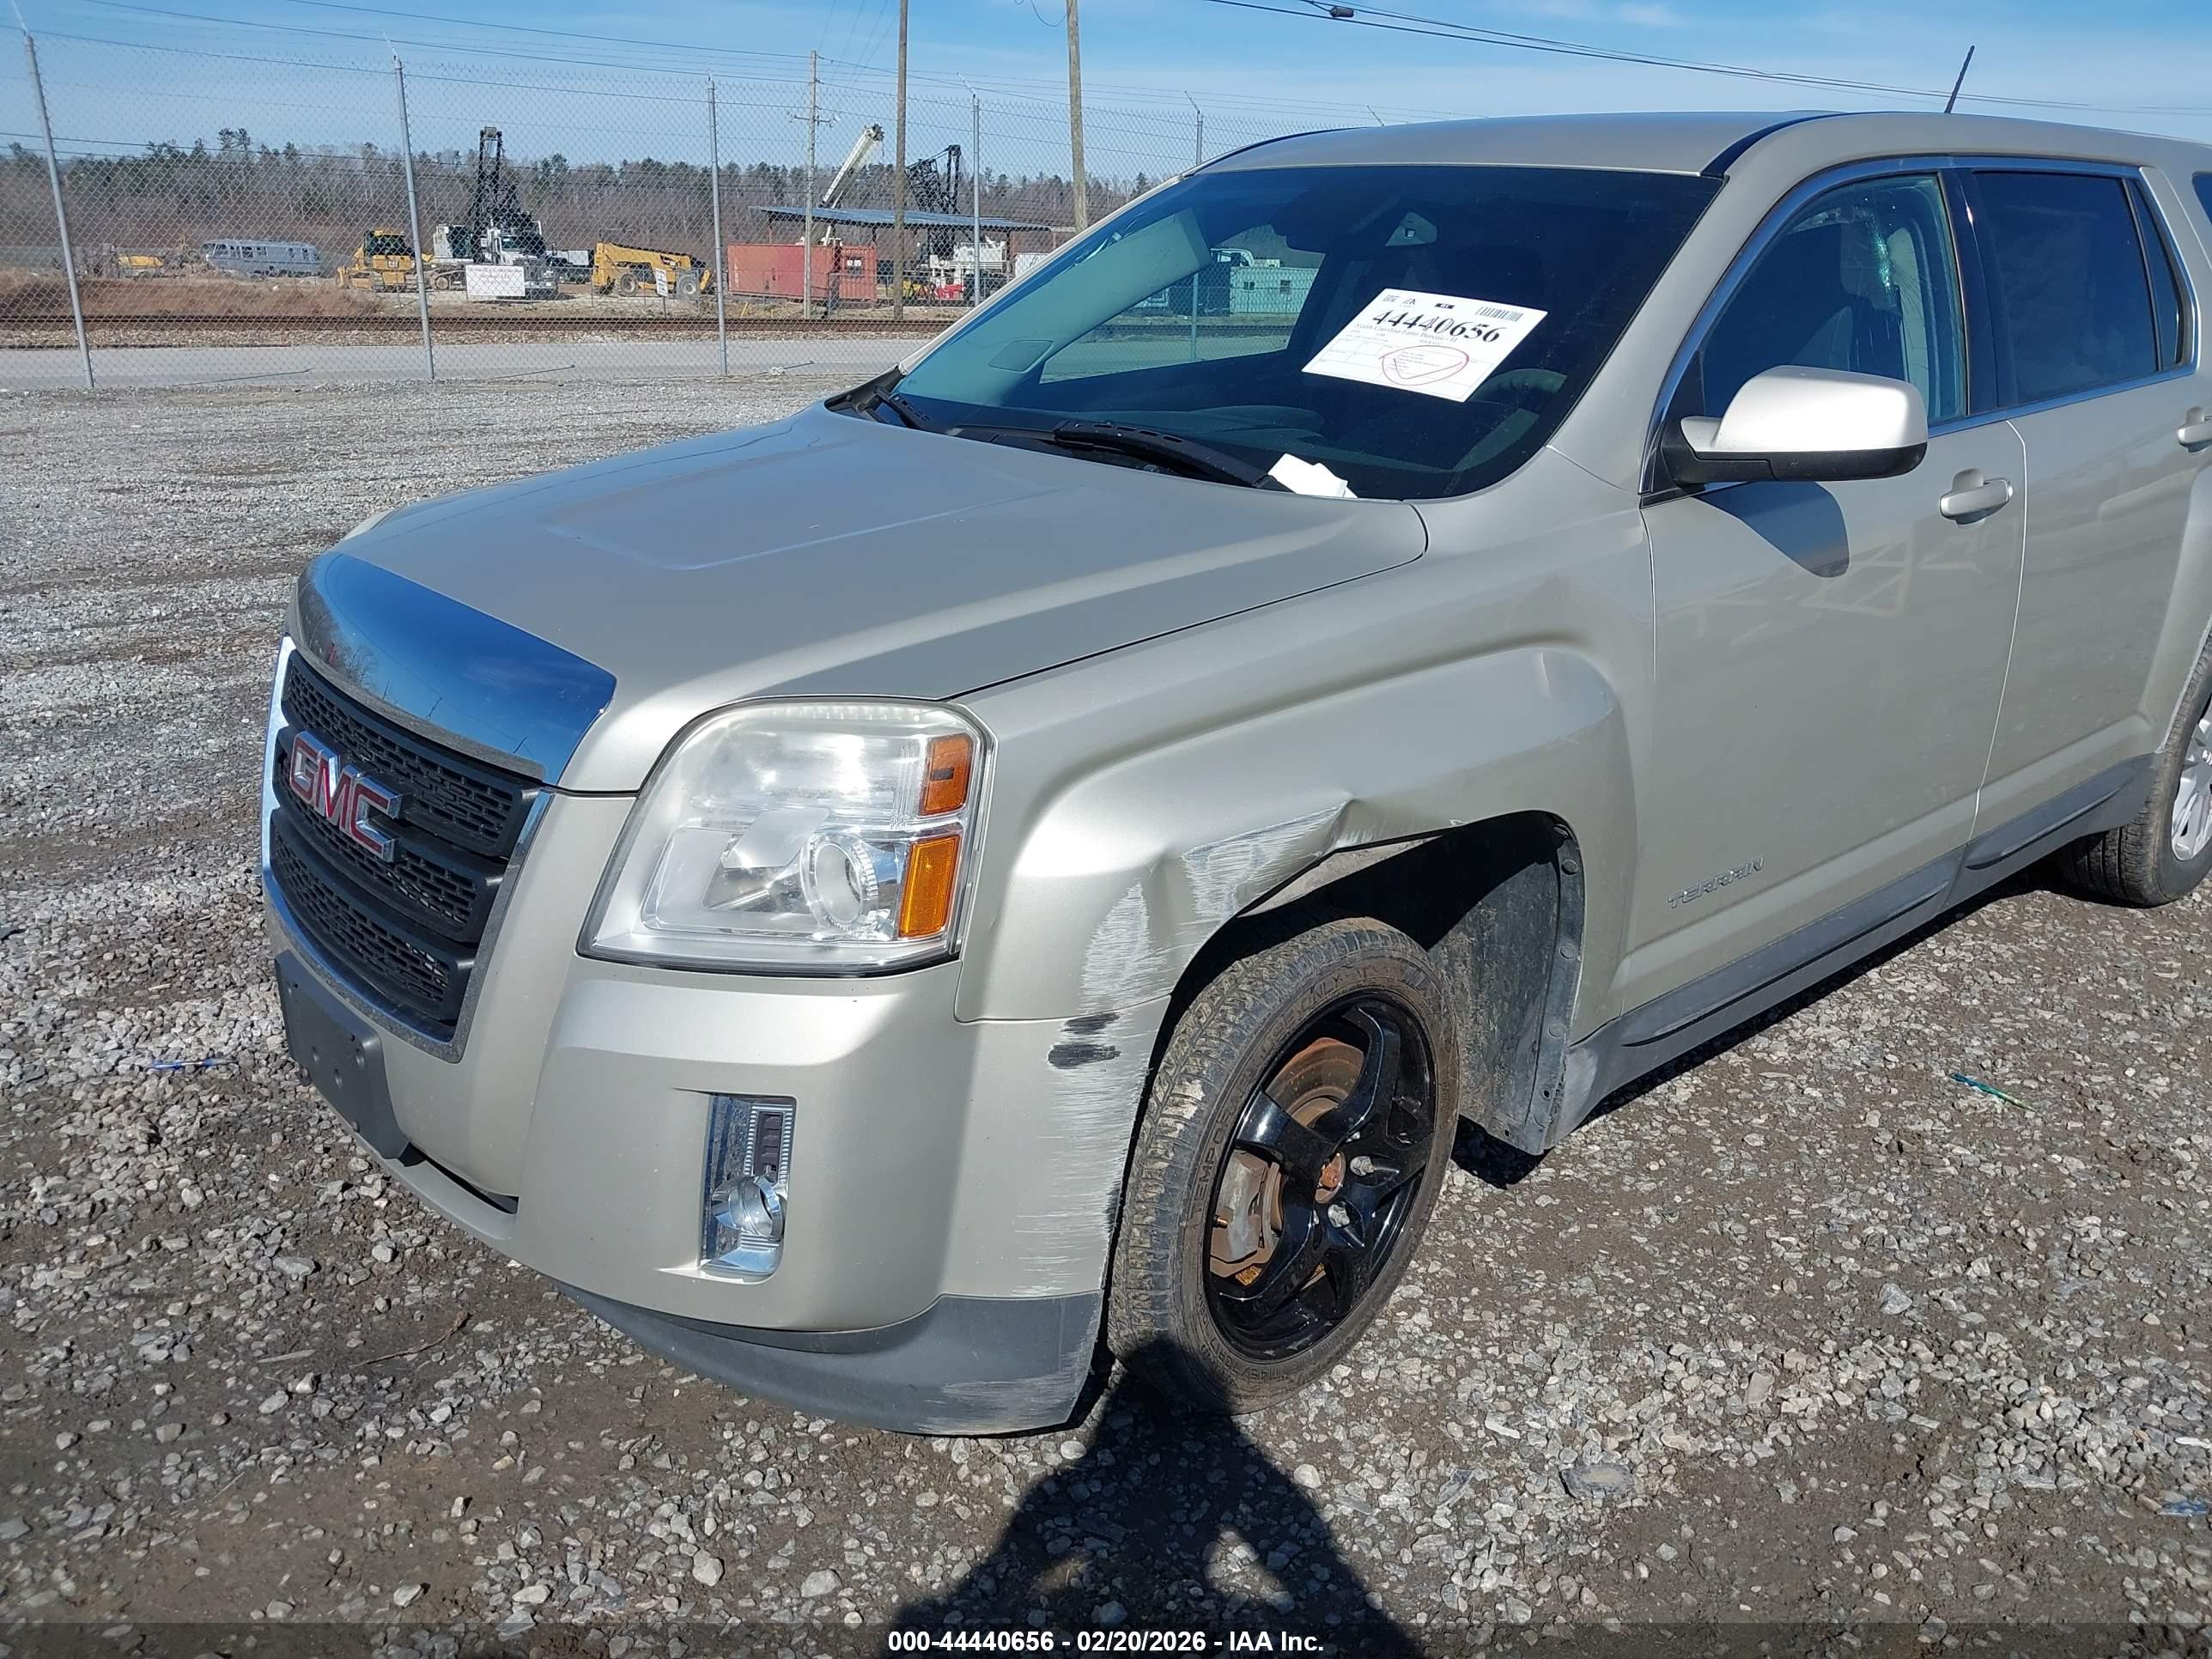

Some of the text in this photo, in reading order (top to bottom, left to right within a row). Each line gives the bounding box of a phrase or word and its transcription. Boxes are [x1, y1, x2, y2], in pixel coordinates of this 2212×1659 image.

[1371, 310, 1507, 343] 44440656
[289, 730, 401, 863] GMC
[1668, 857, 1765, 908] TERRAIN
